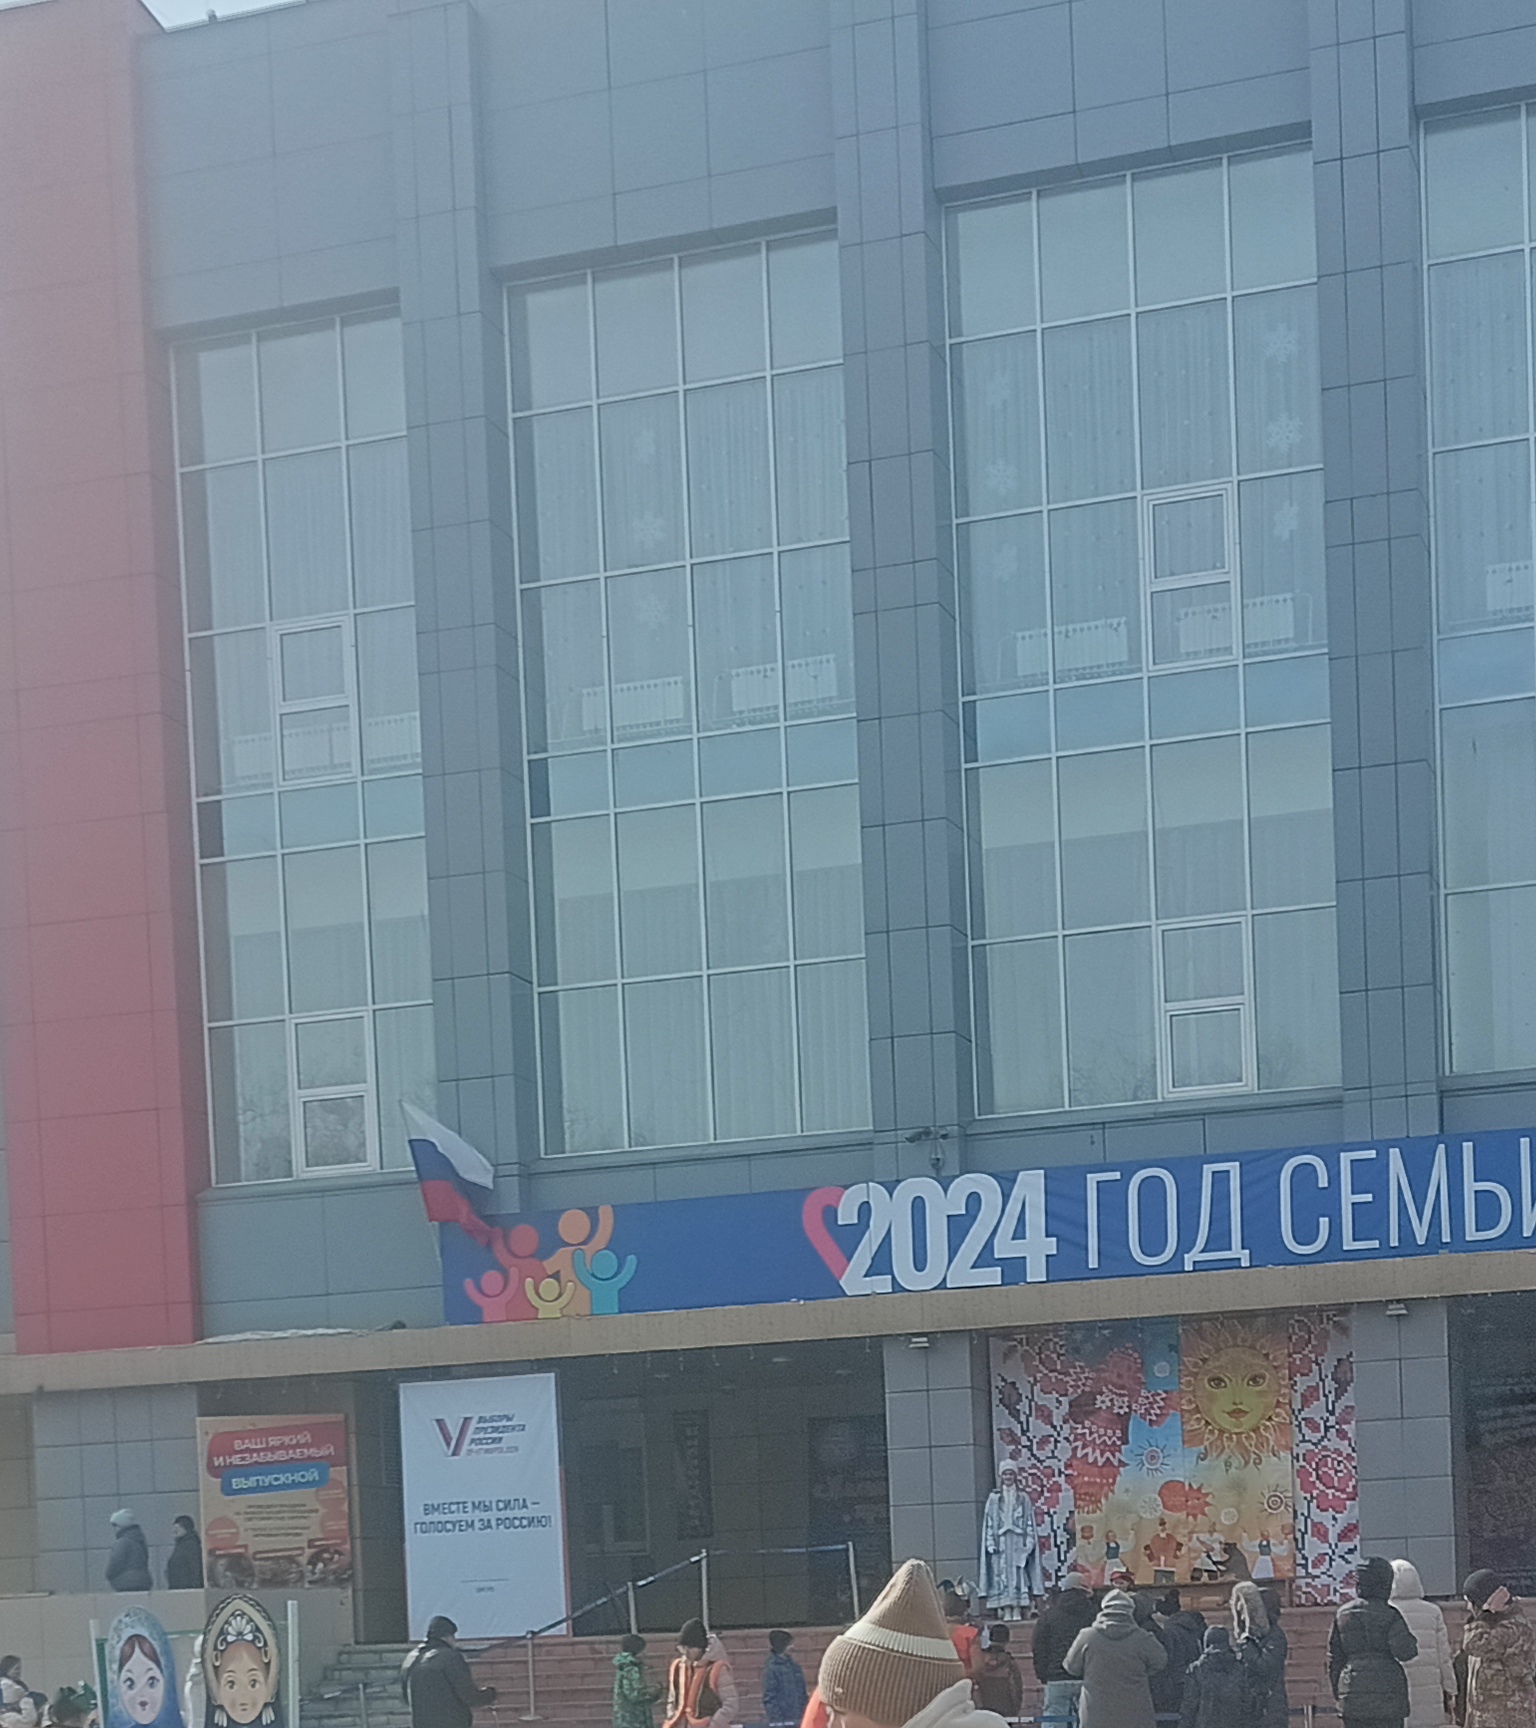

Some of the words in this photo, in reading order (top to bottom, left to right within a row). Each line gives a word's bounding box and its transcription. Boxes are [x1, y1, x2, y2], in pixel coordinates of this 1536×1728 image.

[837, 1169, 1057, 1296] 2024
[1086, 1161, 1250, 1271] ГОД
[234, 1438, 267, 1451] ВАШ
[269, 1431, 312, 1448] ЯРКИЙ
[213, 1456, 225, 1467] И
[226, 1444, 335, 1466] НЕЗАБЫВАЕМЫЙ
[231, 1468, 320, 1490] ВЫПУСКНОЙ
[423, 1501, 469, 1516] ВМЕСТЕ
[472, 1500, 493, 1514] МЫ
[496, 1498, 529, 1511] СИЛА
[414, 1519, 475, 1535] ГОЛОСУЕМ
[478, 1518, 494, 1532] ЗА
[496, 1515, 552, 1531] РОССИЮ!
